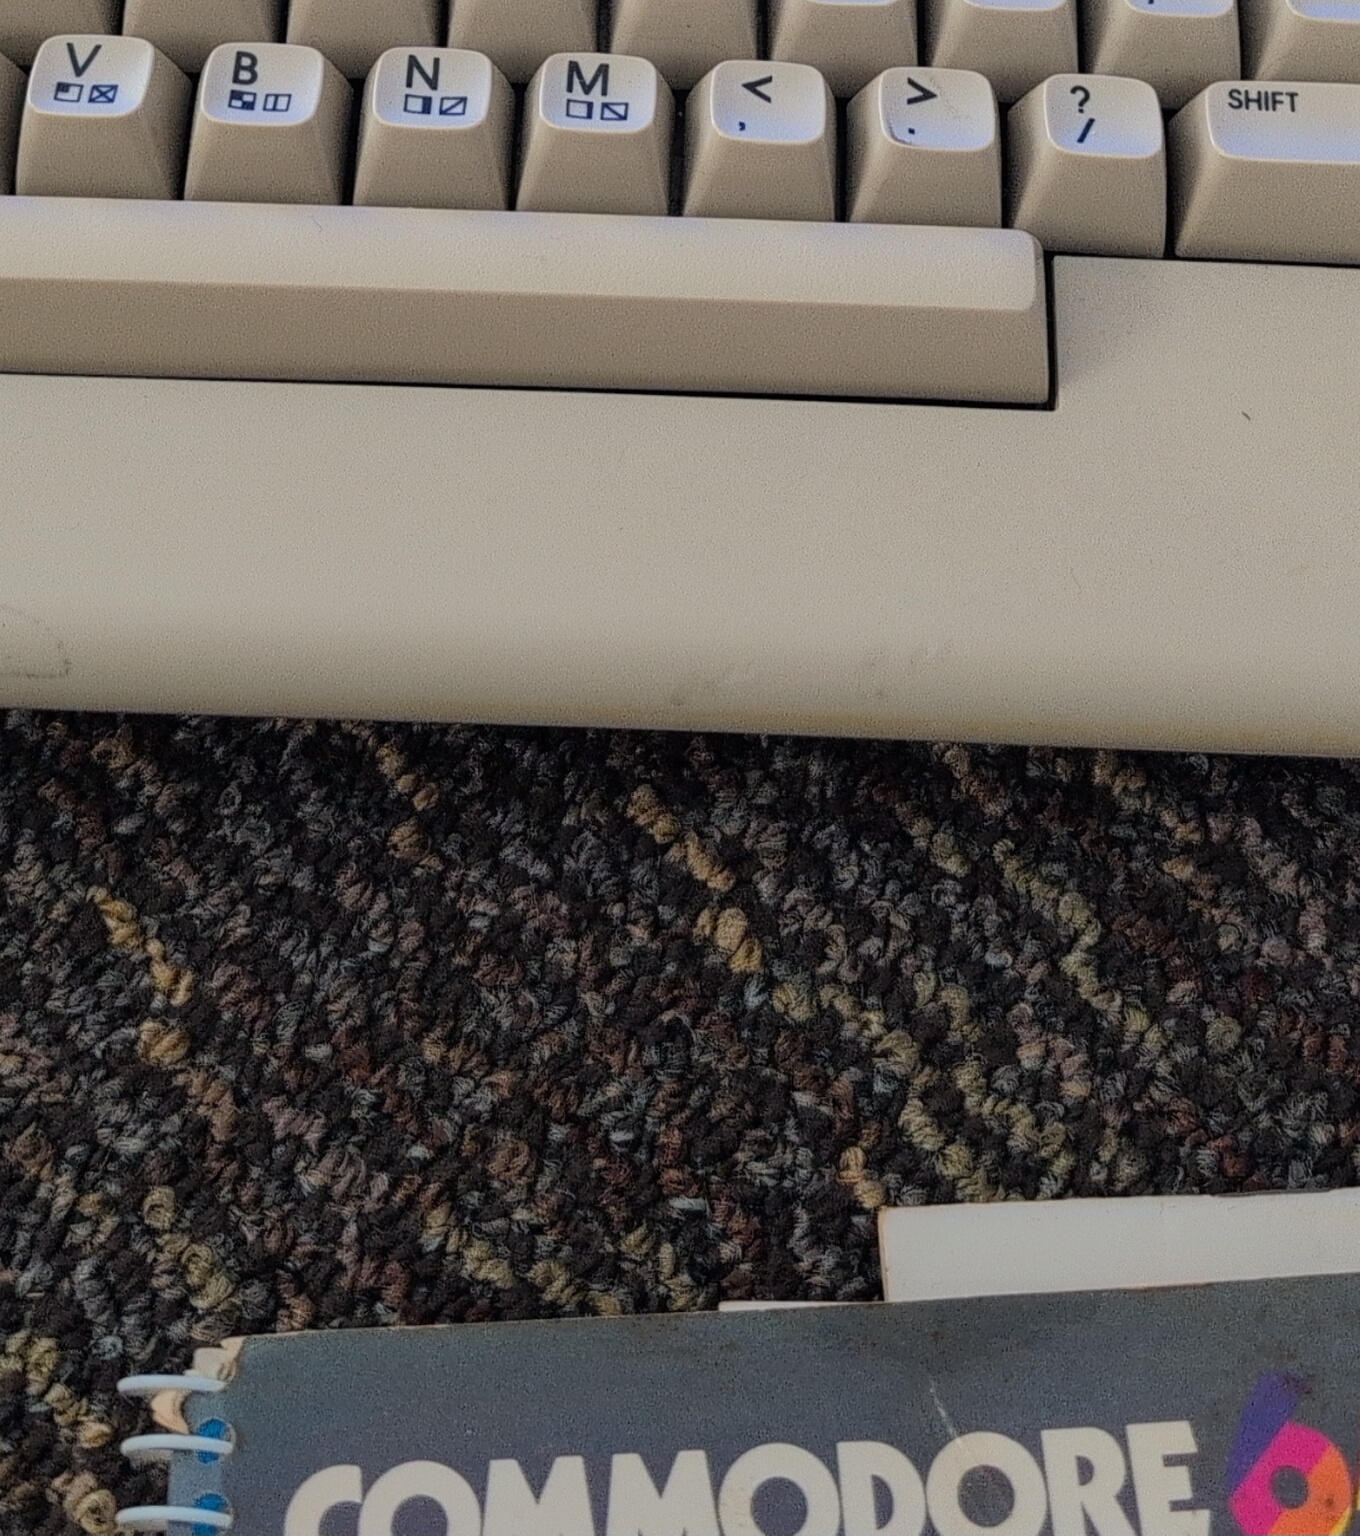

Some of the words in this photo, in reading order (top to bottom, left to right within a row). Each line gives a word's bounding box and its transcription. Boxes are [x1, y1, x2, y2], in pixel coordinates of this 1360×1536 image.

[66, 42, 102, 78] V
[231, 50, 258, 86] B
[405, 54, 440, 91] N
[566, 60, 610, 97] M
[742, 75, 773, 103] <
[906, 77, 937, 105] >
[1070, 85, 1091, 114] ?
[1228, 88, 1299, 113] SHIFT
[283, 1420, 1212, 1536] COMMODORE
